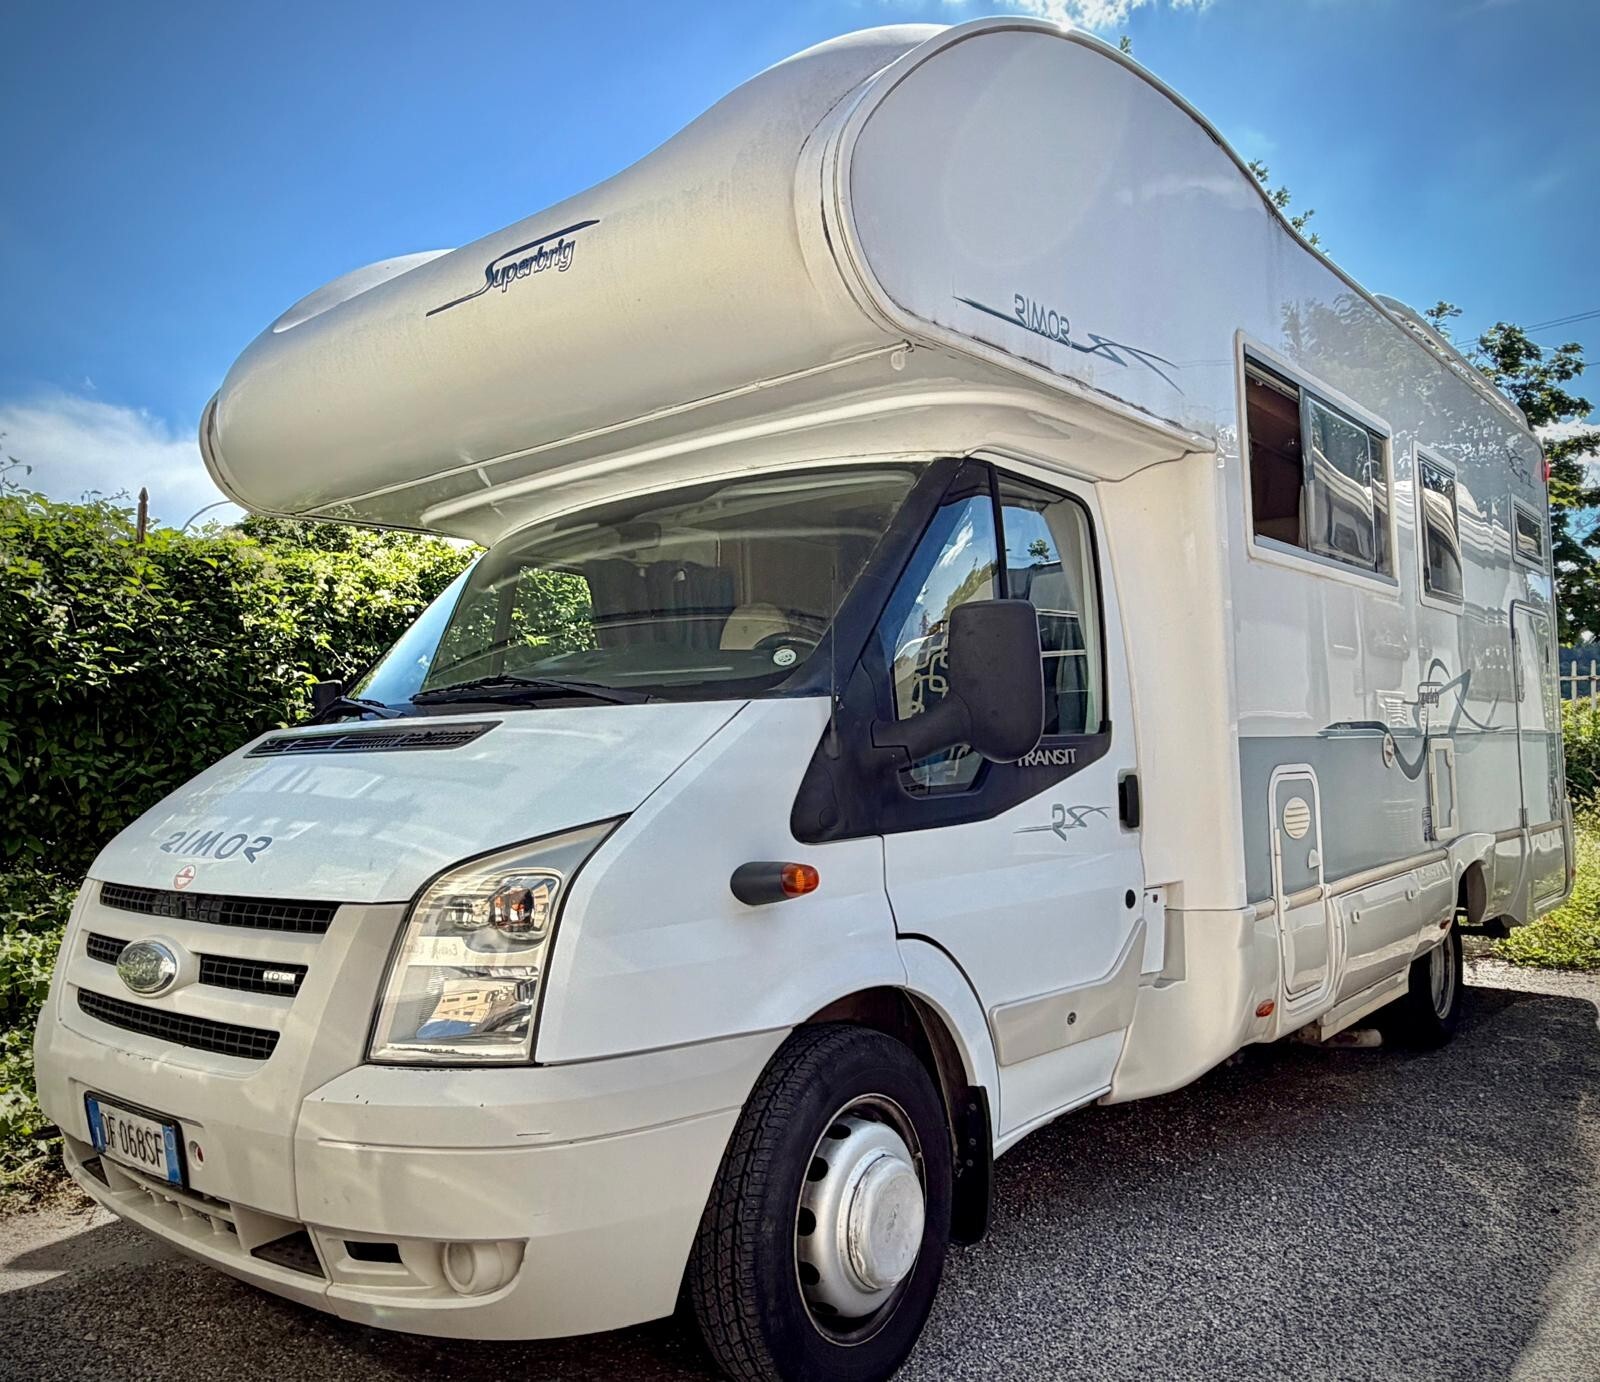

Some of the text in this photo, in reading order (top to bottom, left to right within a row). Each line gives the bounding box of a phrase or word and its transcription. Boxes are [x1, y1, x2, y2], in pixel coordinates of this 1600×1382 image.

[485, 238, 576, 293] Superbrig
[1014, 293, 1070, 346] RIMOR
[160, 829, 272, 864] RIMOR
[119, 1120, 164, 1168] 068SF
